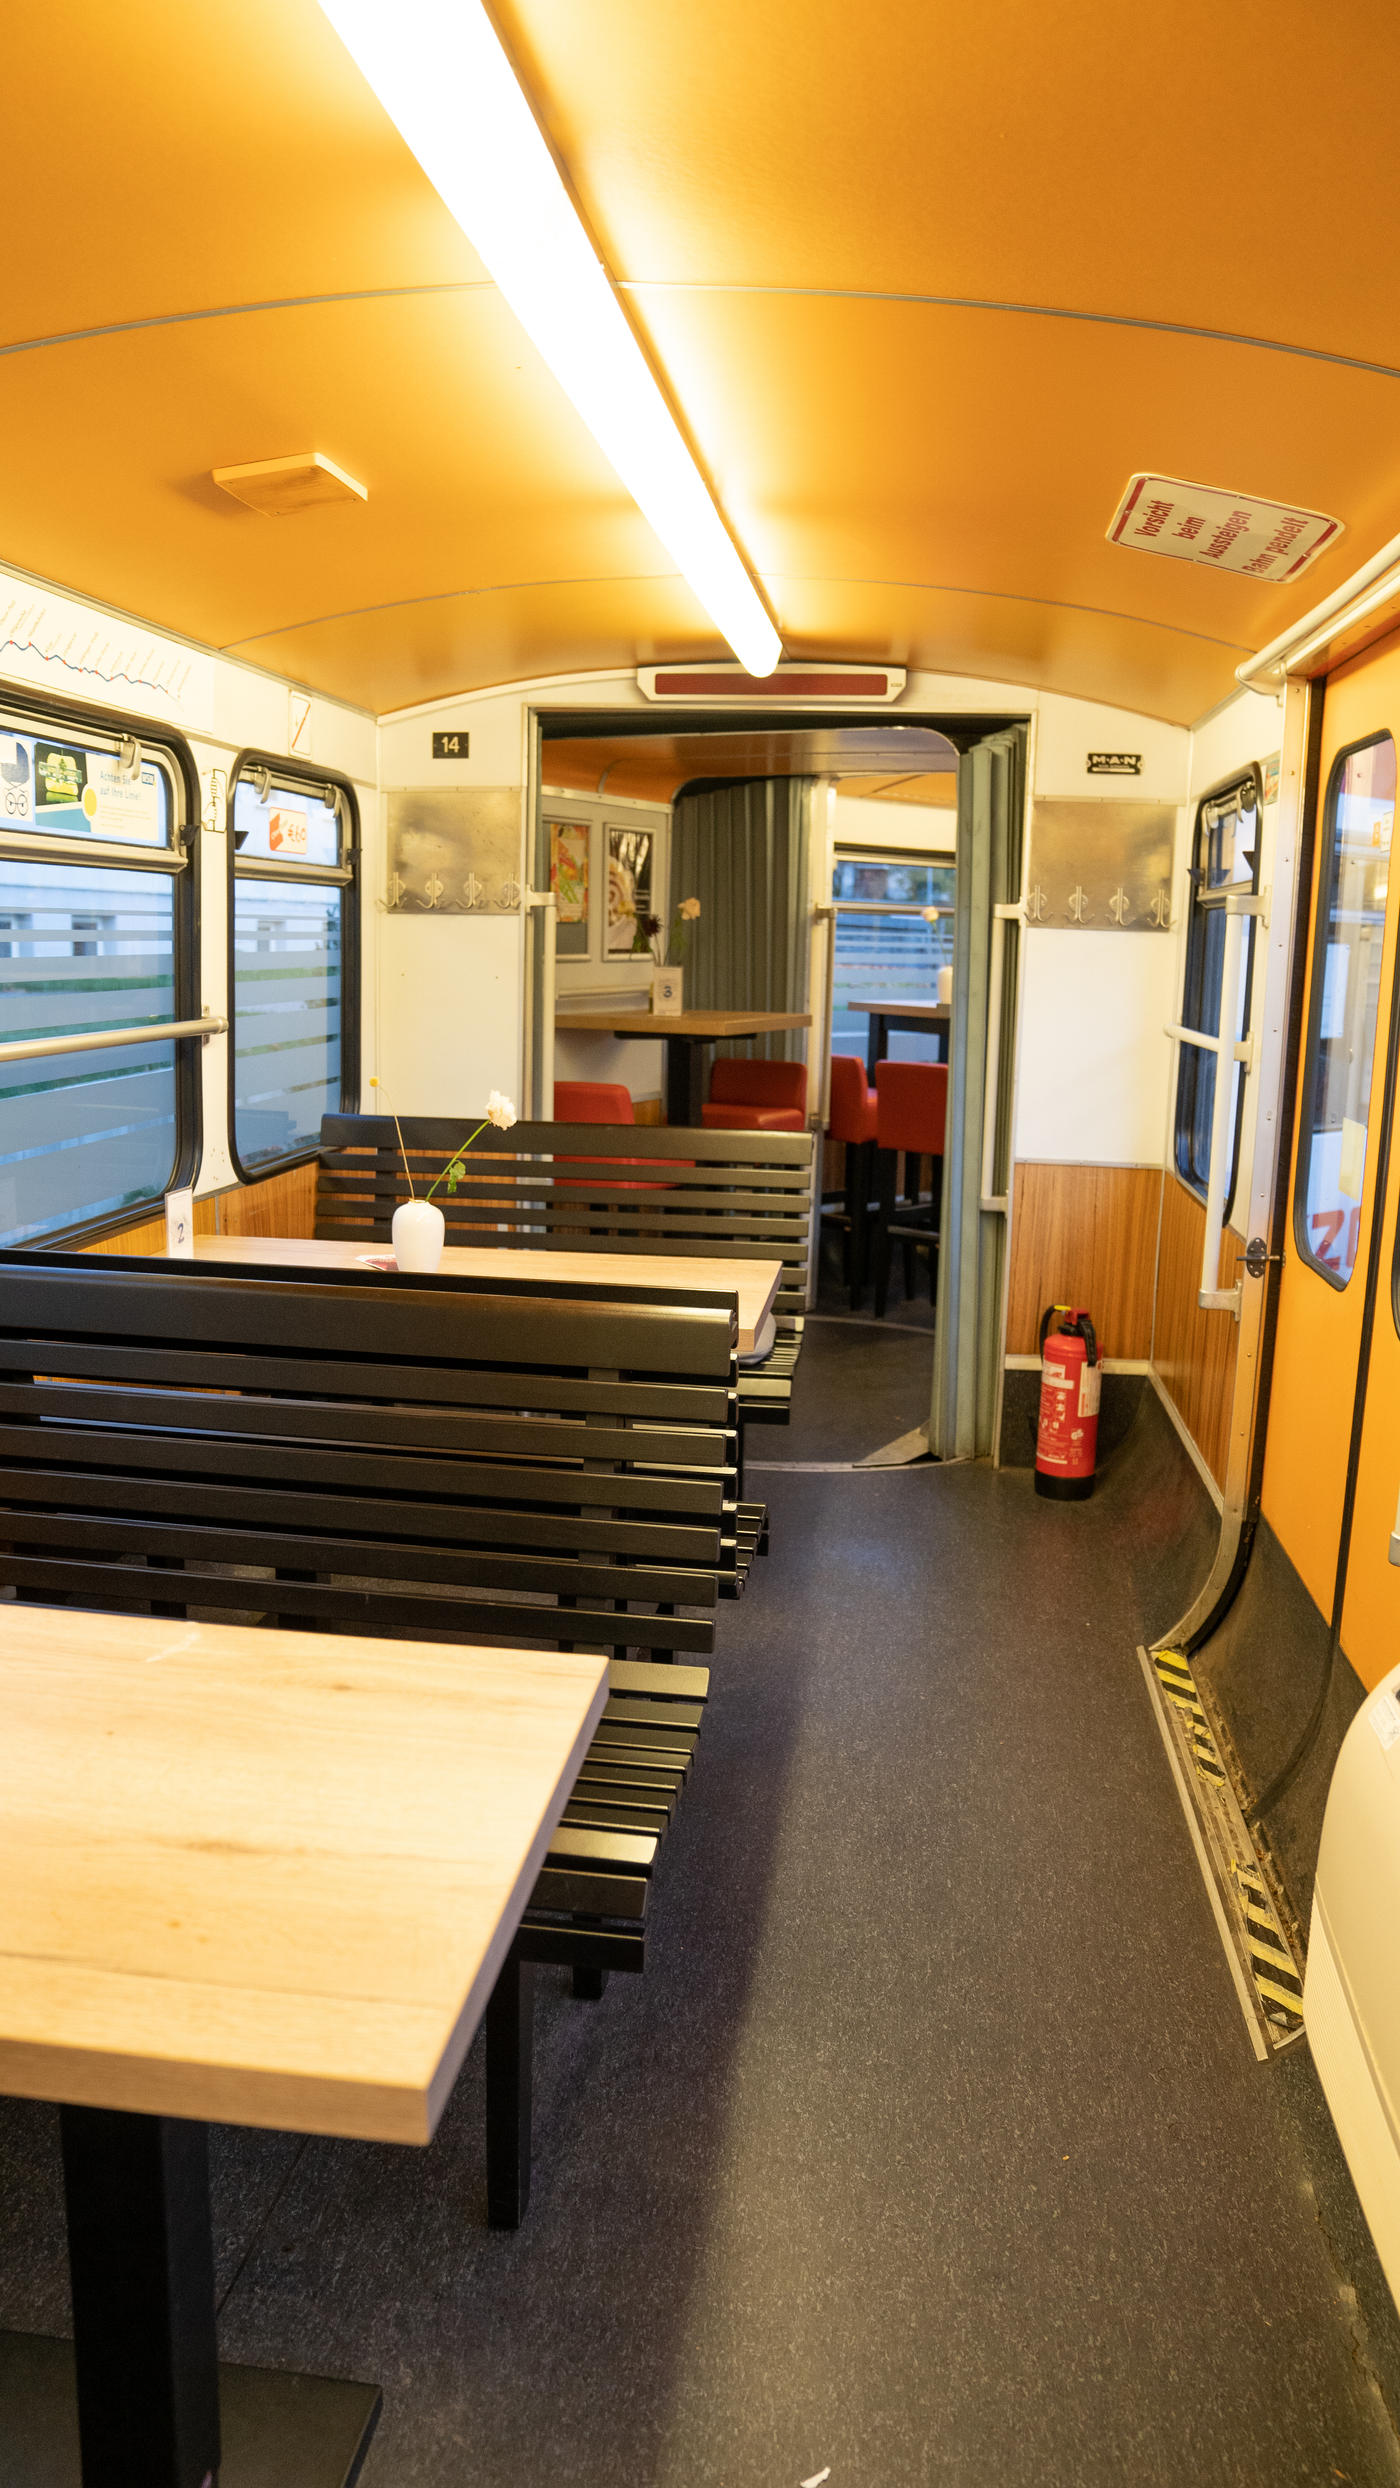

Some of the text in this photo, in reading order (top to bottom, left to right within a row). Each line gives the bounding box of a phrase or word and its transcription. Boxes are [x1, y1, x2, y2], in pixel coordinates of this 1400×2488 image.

[1134, 500, 1175, 537] Vorsicht
[1171, 516, 1206, 540] beim
[1199, 510, 1252, 559] Aussteigen
[1241, 517, 1309, 574] Bahn pendelt
[441, 735, 460, 753] 14
[663, 985, 672, 998] 3
[177, 1222, 184, 1243] 2
